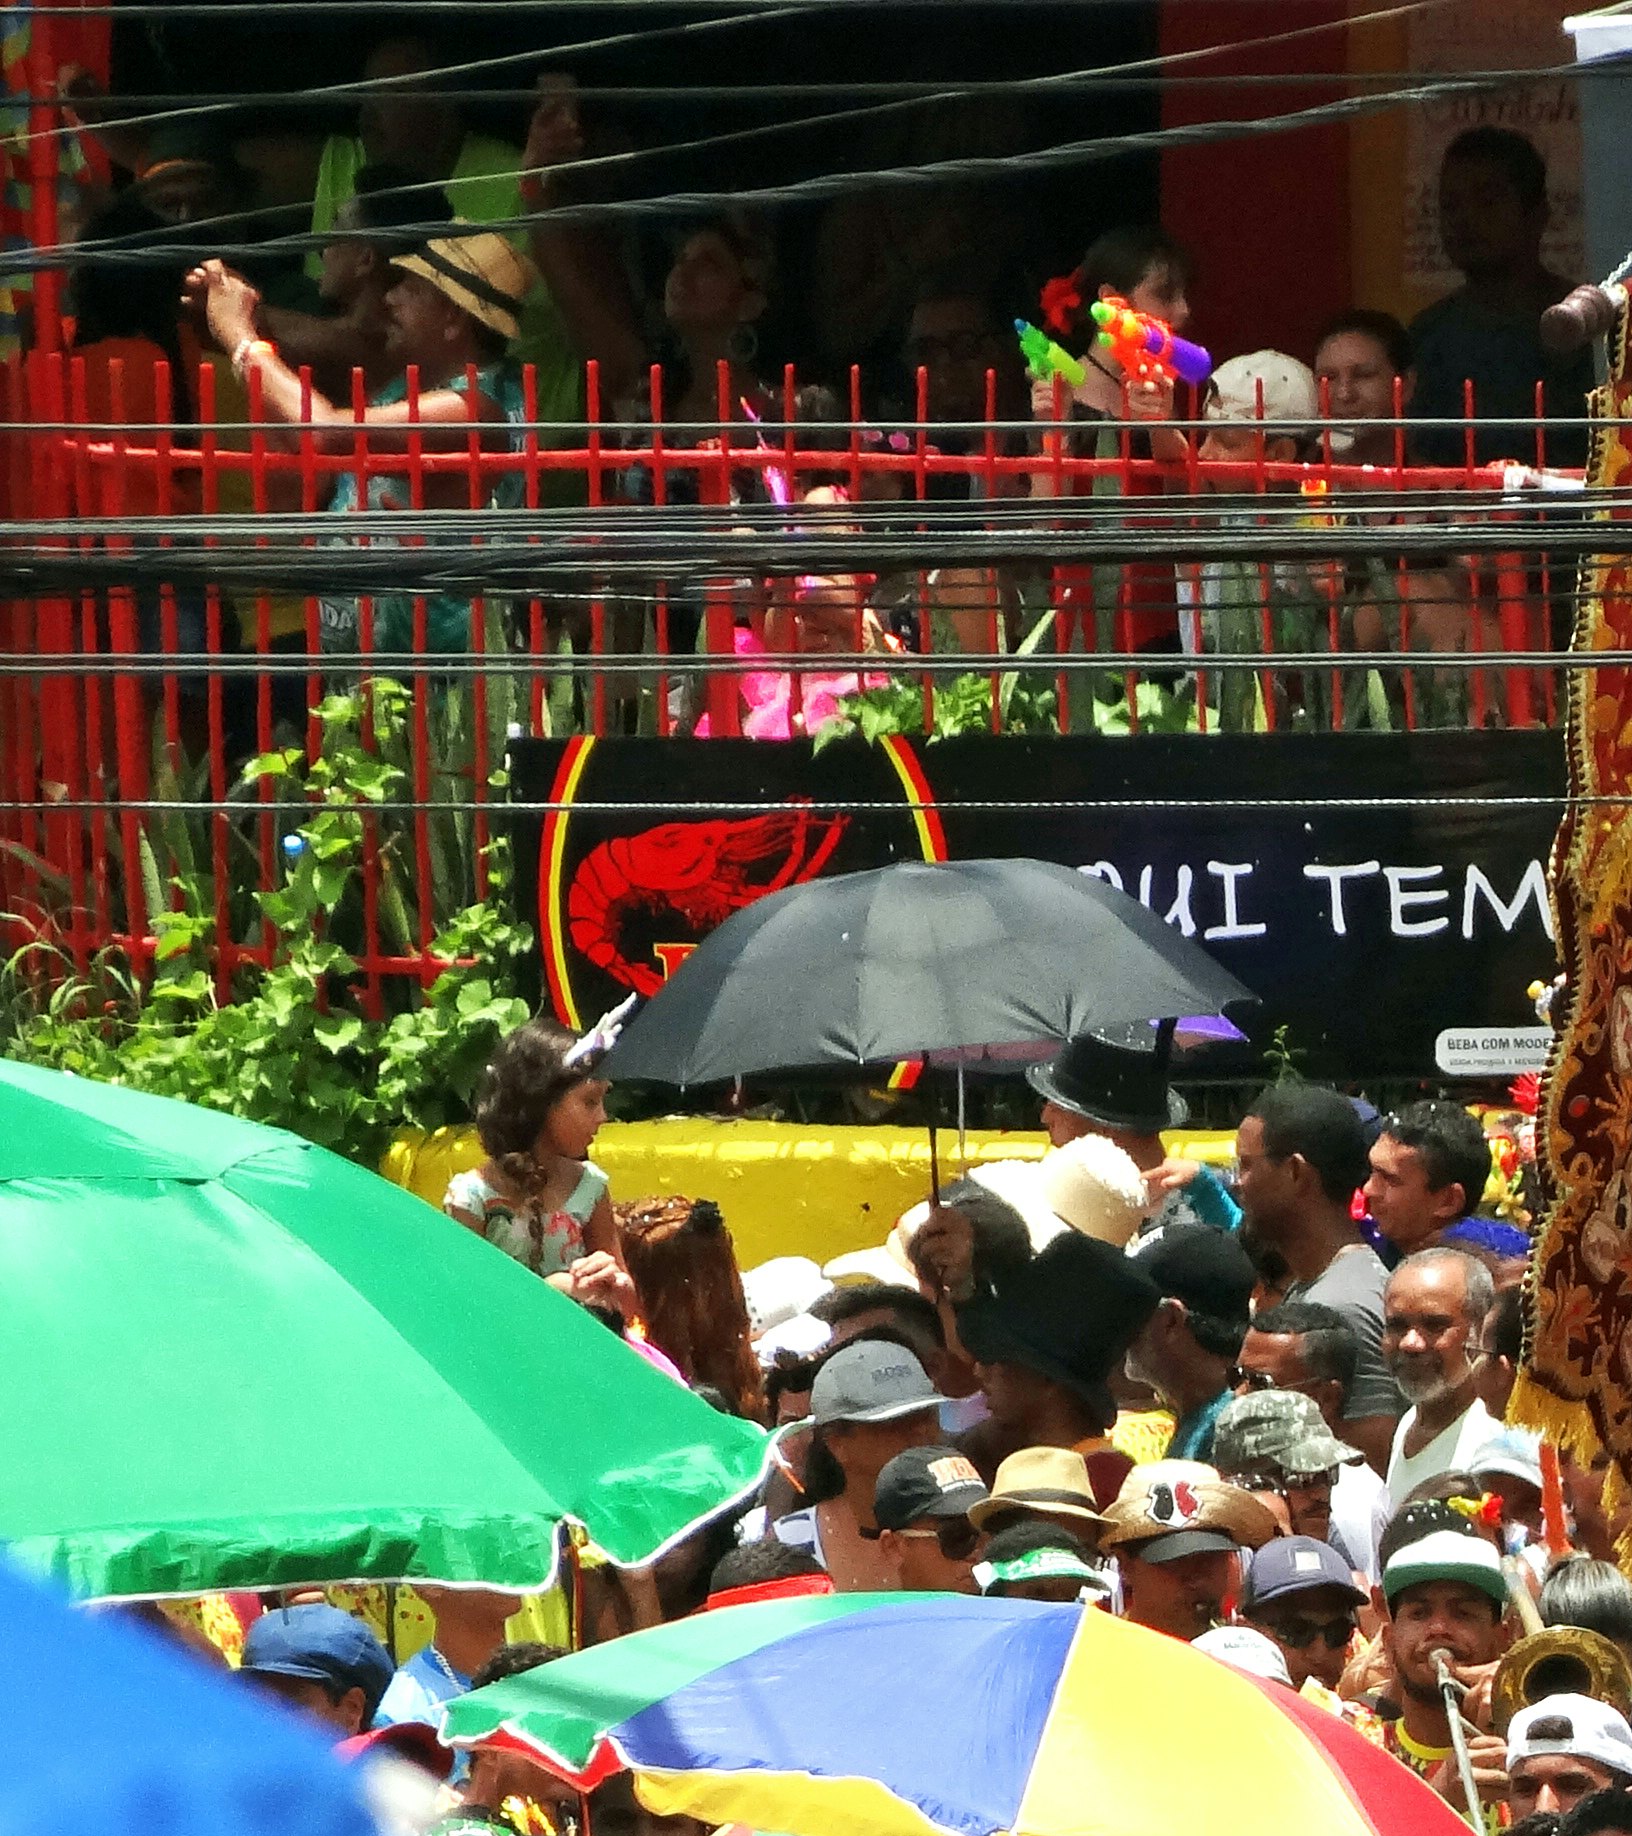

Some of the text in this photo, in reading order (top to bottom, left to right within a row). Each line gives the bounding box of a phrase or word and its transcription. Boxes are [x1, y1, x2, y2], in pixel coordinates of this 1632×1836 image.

[1304, 859, 1554, 945] TEM
[1447, 1038, 1478, 1050] BEBA
[1481, 1038, 1510, 1051] COM
